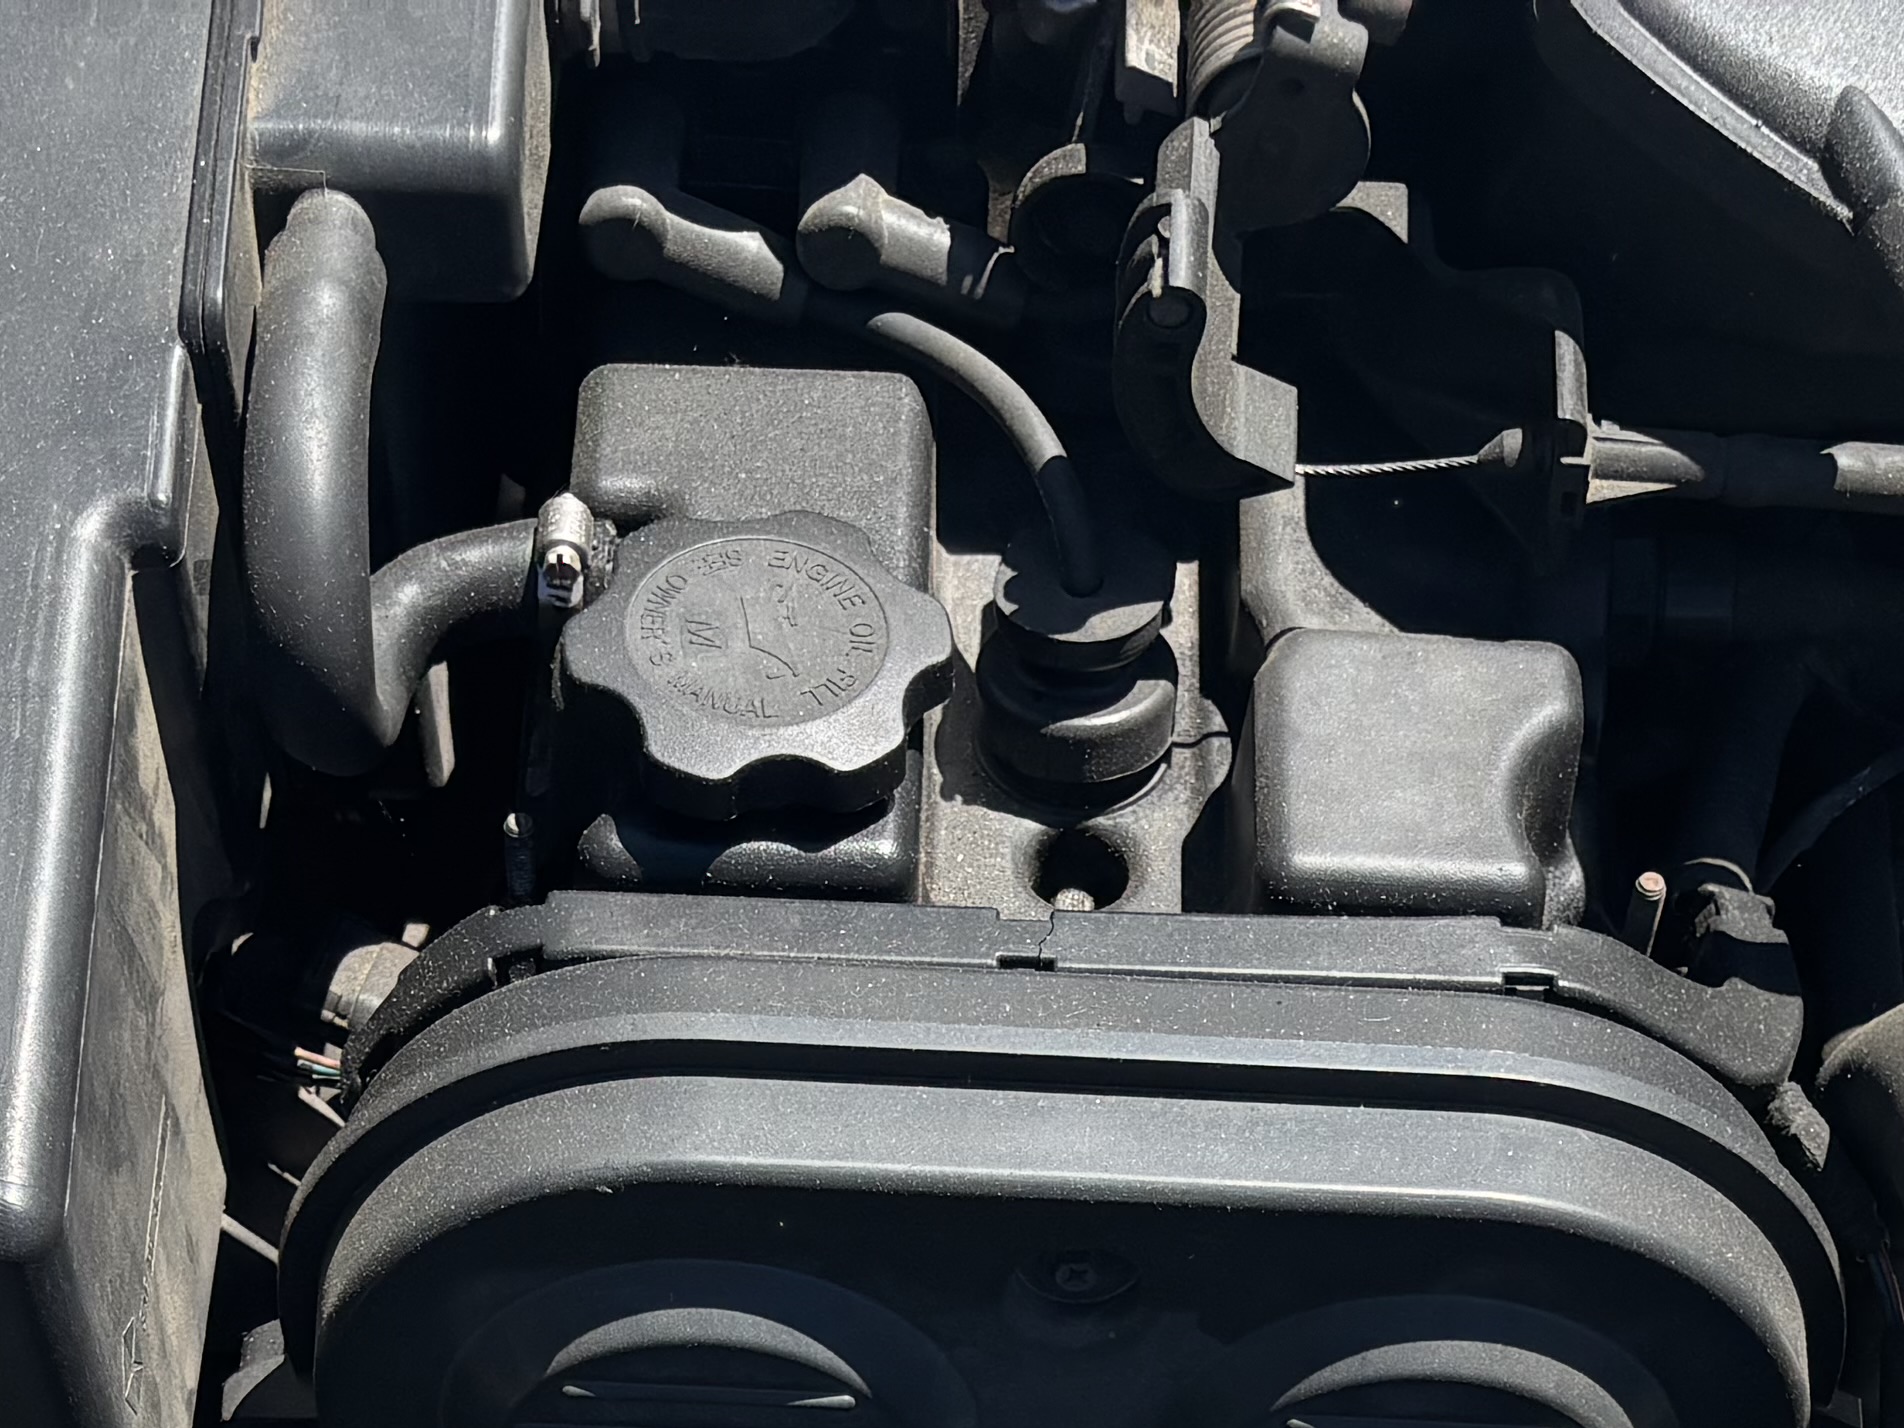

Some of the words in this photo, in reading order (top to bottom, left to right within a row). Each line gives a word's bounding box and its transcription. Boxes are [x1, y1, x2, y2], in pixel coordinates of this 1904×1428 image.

[767, 549, 867, 611] ENGINE
[848, 622, 877, 658] OIL
[667, 671, 780, 719] MANUAL
[800, 667, 858, 707] FILL
